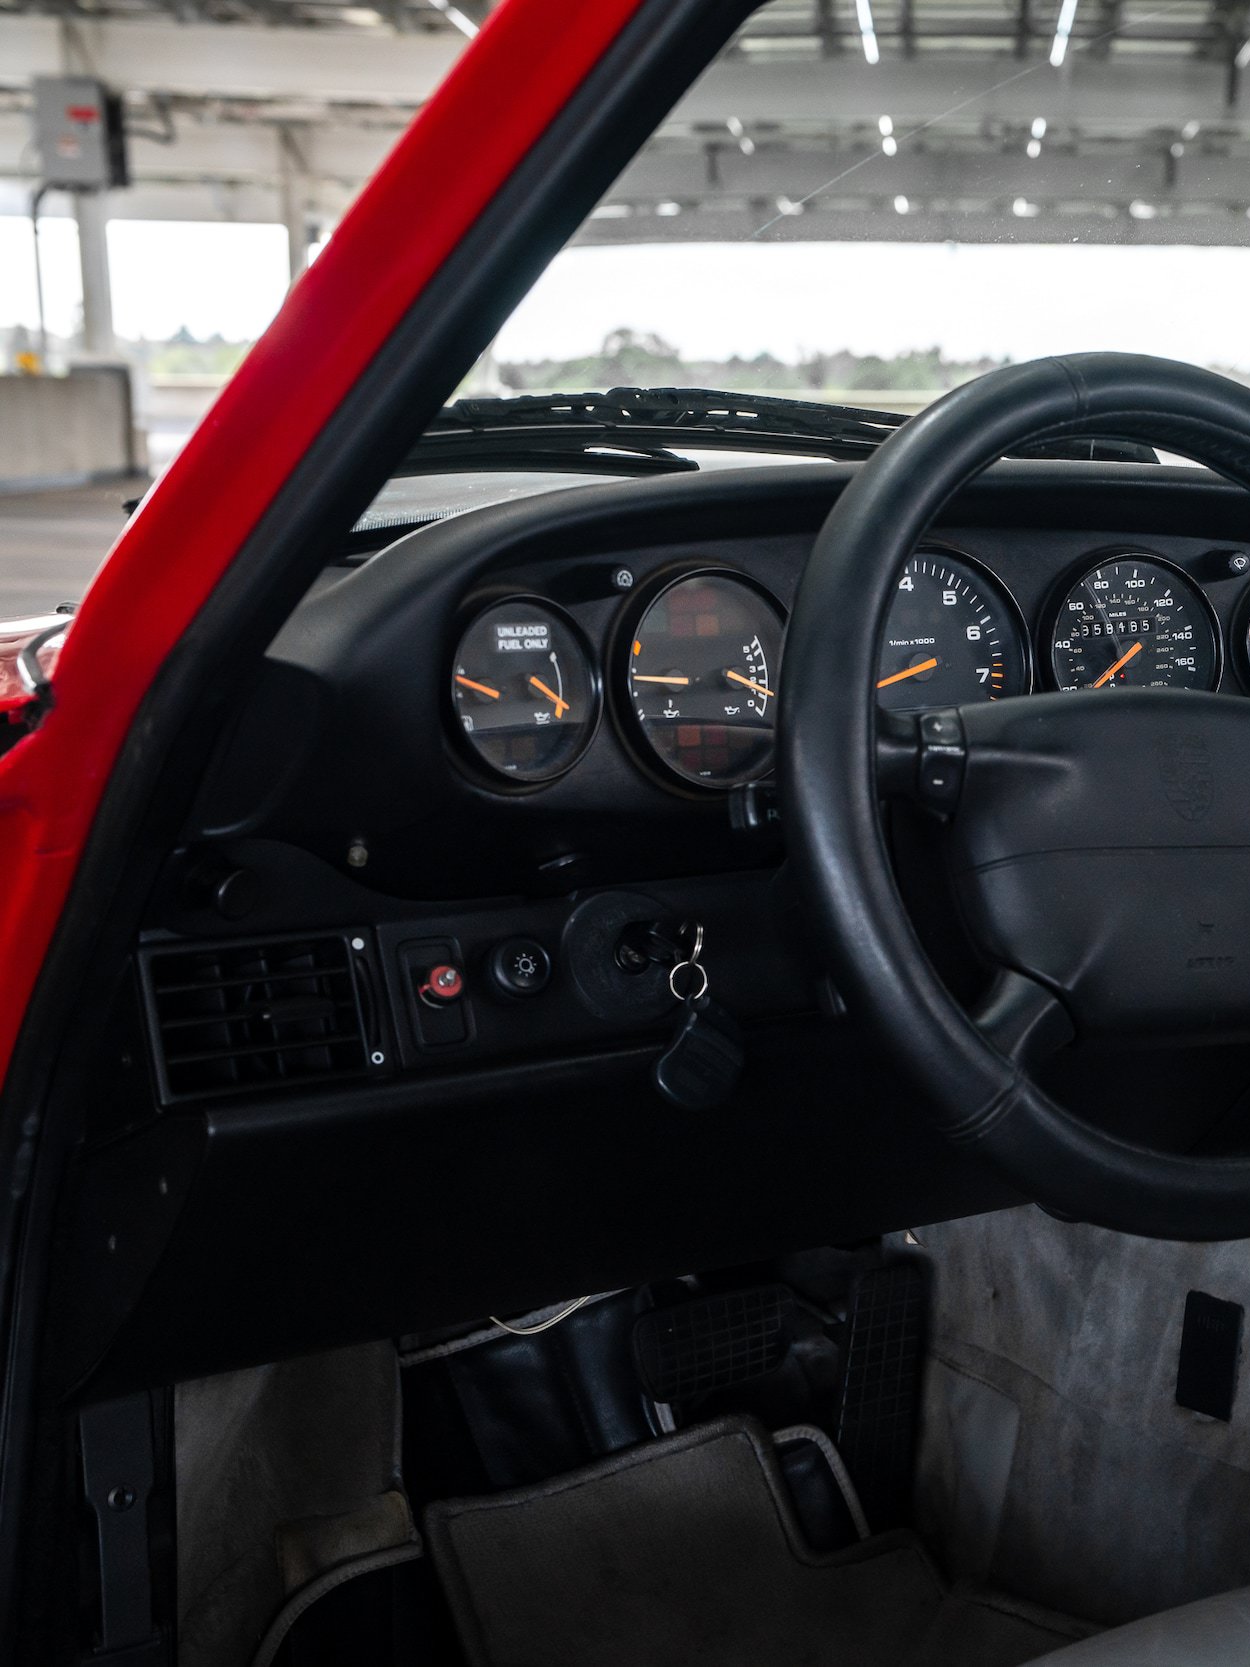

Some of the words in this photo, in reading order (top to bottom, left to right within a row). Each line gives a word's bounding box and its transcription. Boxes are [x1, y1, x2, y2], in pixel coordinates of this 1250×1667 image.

[899, 576, 914, 591] 4
[1093, 581, 1109, 589] 80
[1125, 580, 1145, 588] 100
[942, 591, 957, 605] 5
[1154, 598, 1173, 607] 120
[1069, 602, 1084, 611] 60
[497, 626, 548, 637] UNLEADED
[966, 626, 981, 640] 6
[1172, 632, 1193, 640] 140
[498, 639, 523, 650] FUEL
[524, 638, 549, 649] ONLY
[743, 645, 750, 653] 5
[1175, 657, 1195, 666] 160
[749, 665, 756, 673] 3
[976, 668, 990, 683] 7
